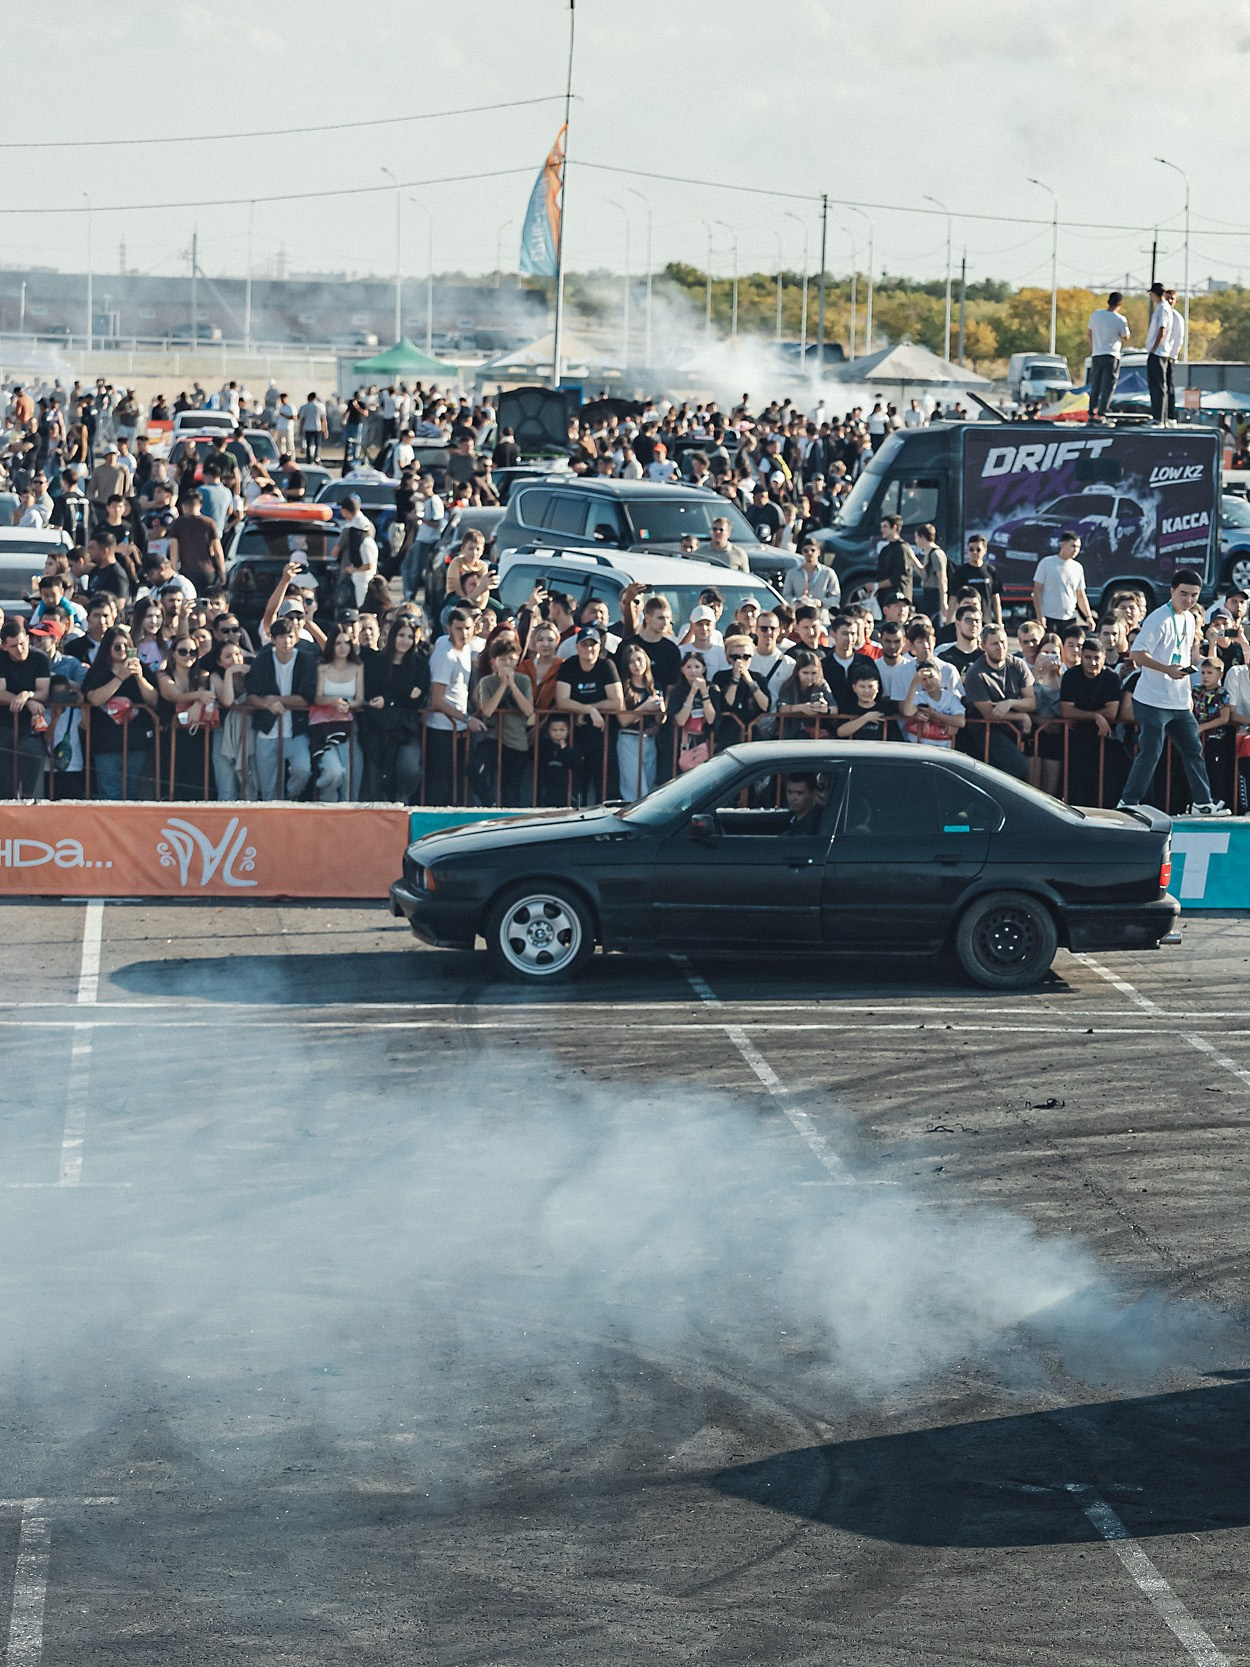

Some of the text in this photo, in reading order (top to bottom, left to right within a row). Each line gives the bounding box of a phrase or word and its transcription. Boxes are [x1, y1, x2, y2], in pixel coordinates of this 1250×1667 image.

[981, 438, 1113, 477] DRIFT
[1150, 465, 1204, 482] LOW KZ
